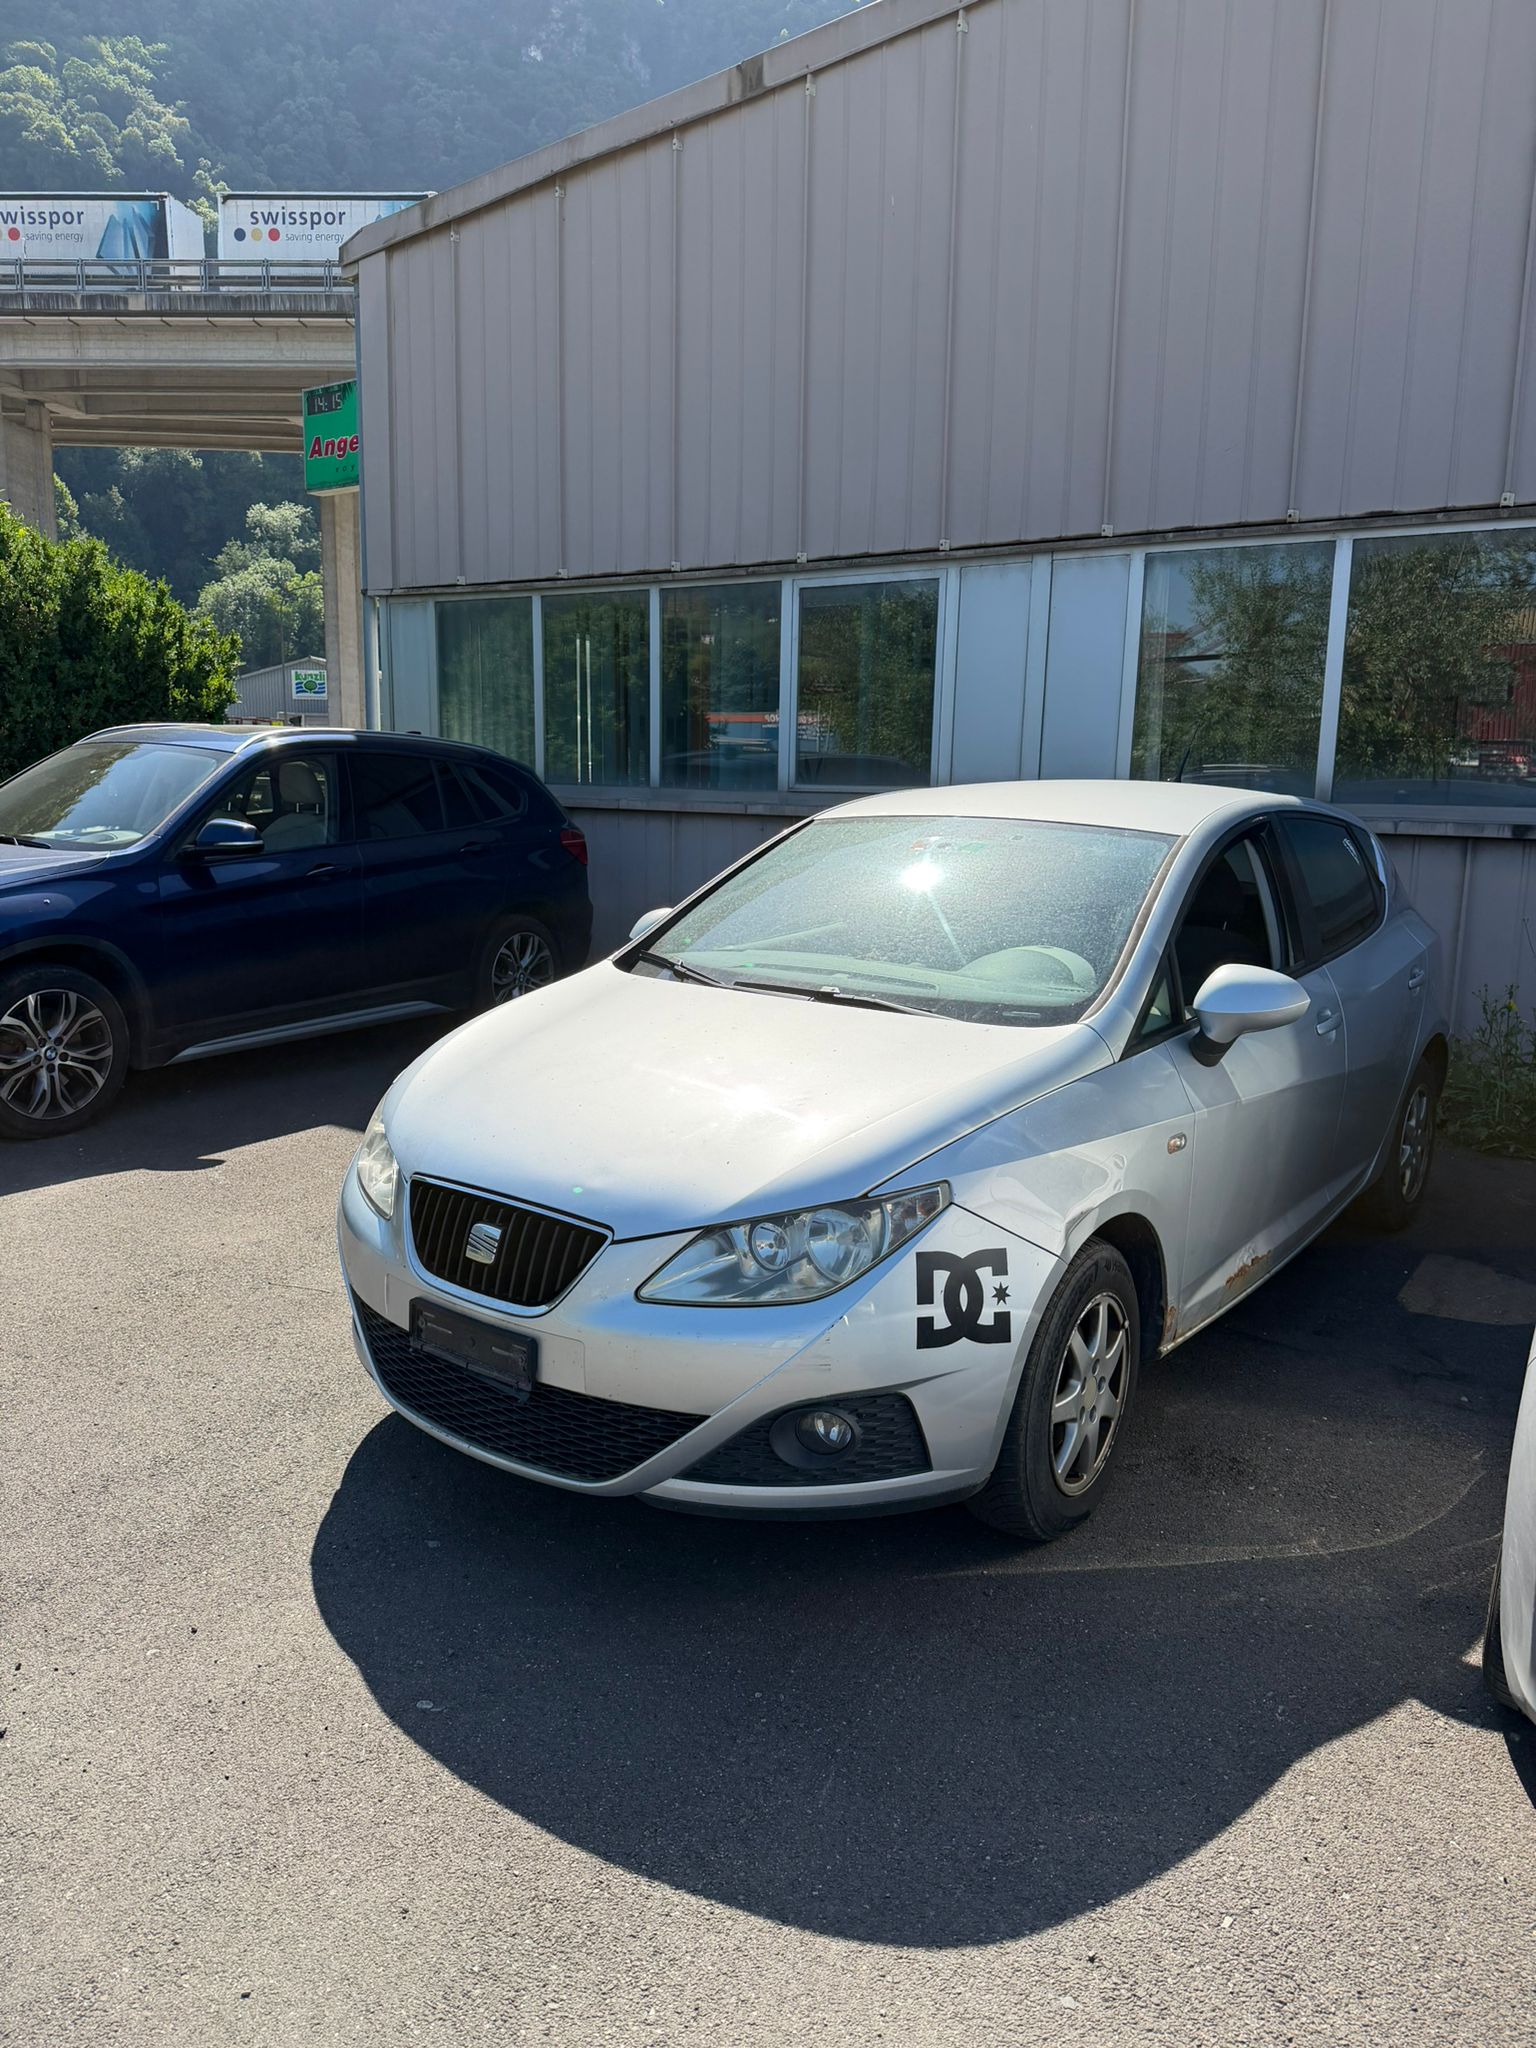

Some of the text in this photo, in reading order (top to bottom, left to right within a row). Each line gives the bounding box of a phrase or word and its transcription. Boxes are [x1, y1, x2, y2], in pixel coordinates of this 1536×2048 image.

[250, 206, 346, 230] swisspor
[25, 231, 84, 243] saving energy
[285, 232, 344, 244] saving energy
[314, 392, 343, 412] 14:15
[308, 435, 359, 460] Ange
[916, 1248, 1011, 1349] DC
